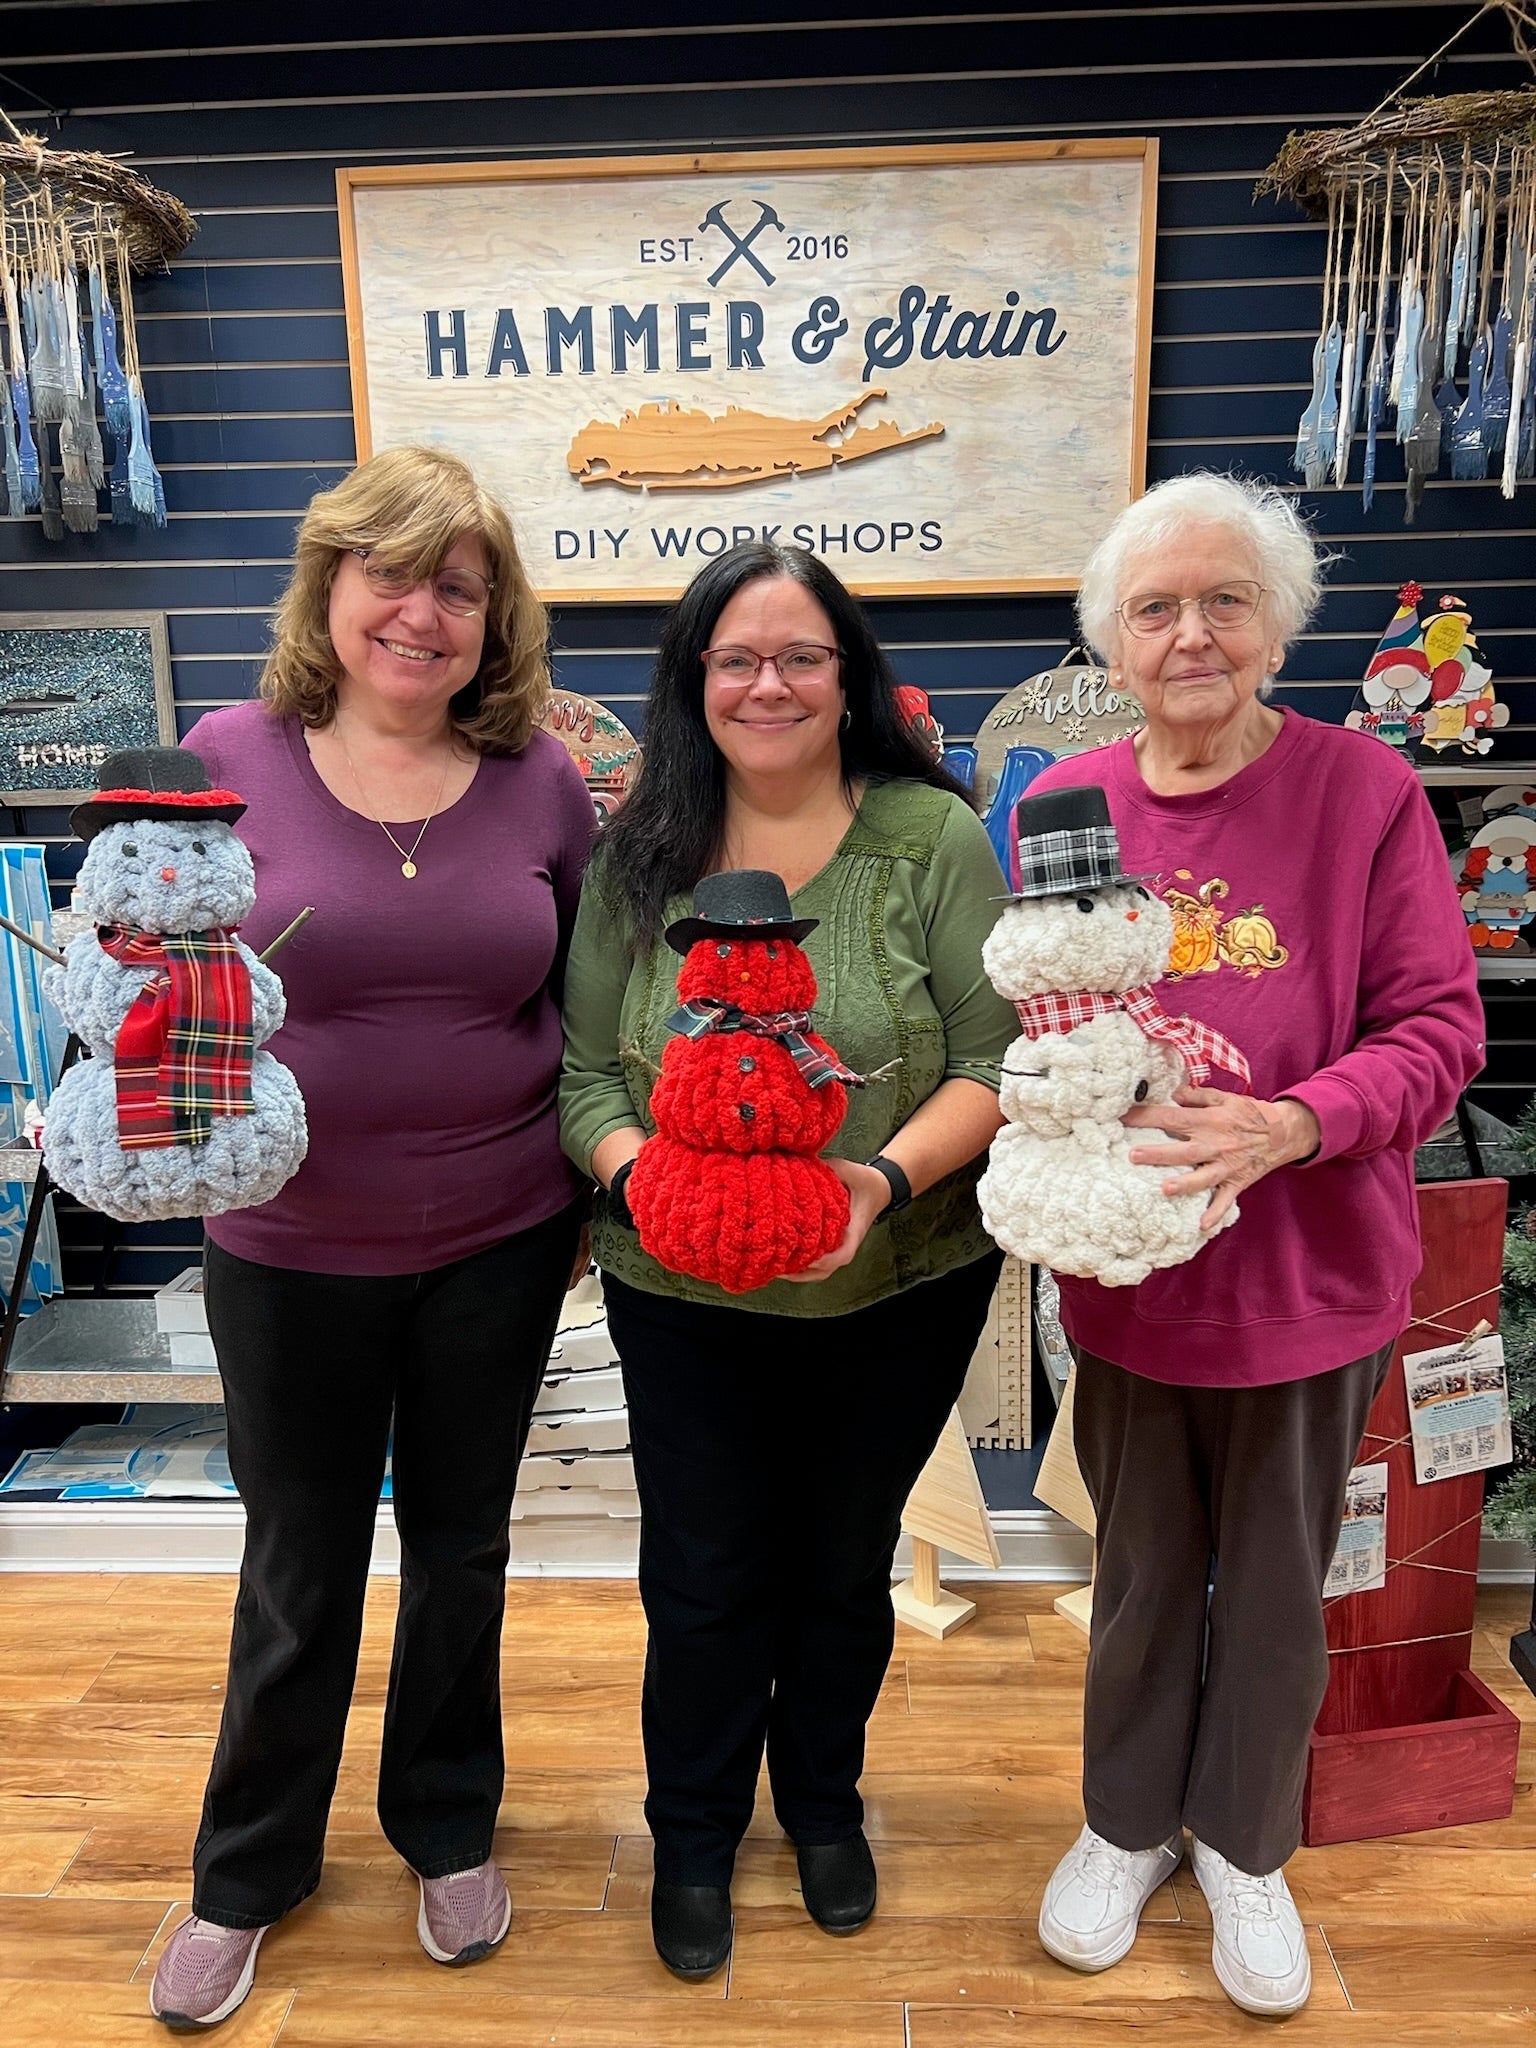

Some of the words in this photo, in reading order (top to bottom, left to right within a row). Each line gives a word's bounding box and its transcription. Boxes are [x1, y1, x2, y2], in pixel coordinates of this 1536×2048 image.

[640, 237, 703, 263] EST.
[786, 234, 849, 260] 2016
[423, 300, 766, 379] HAMMER
[791, 295, 848, 364] &
[862, 284, 1067, 383] Stain
[555, 528, 630, 560] DIY
[1034, 671, 1121, 724] hello
[17, 743, 109, 770] HOME
